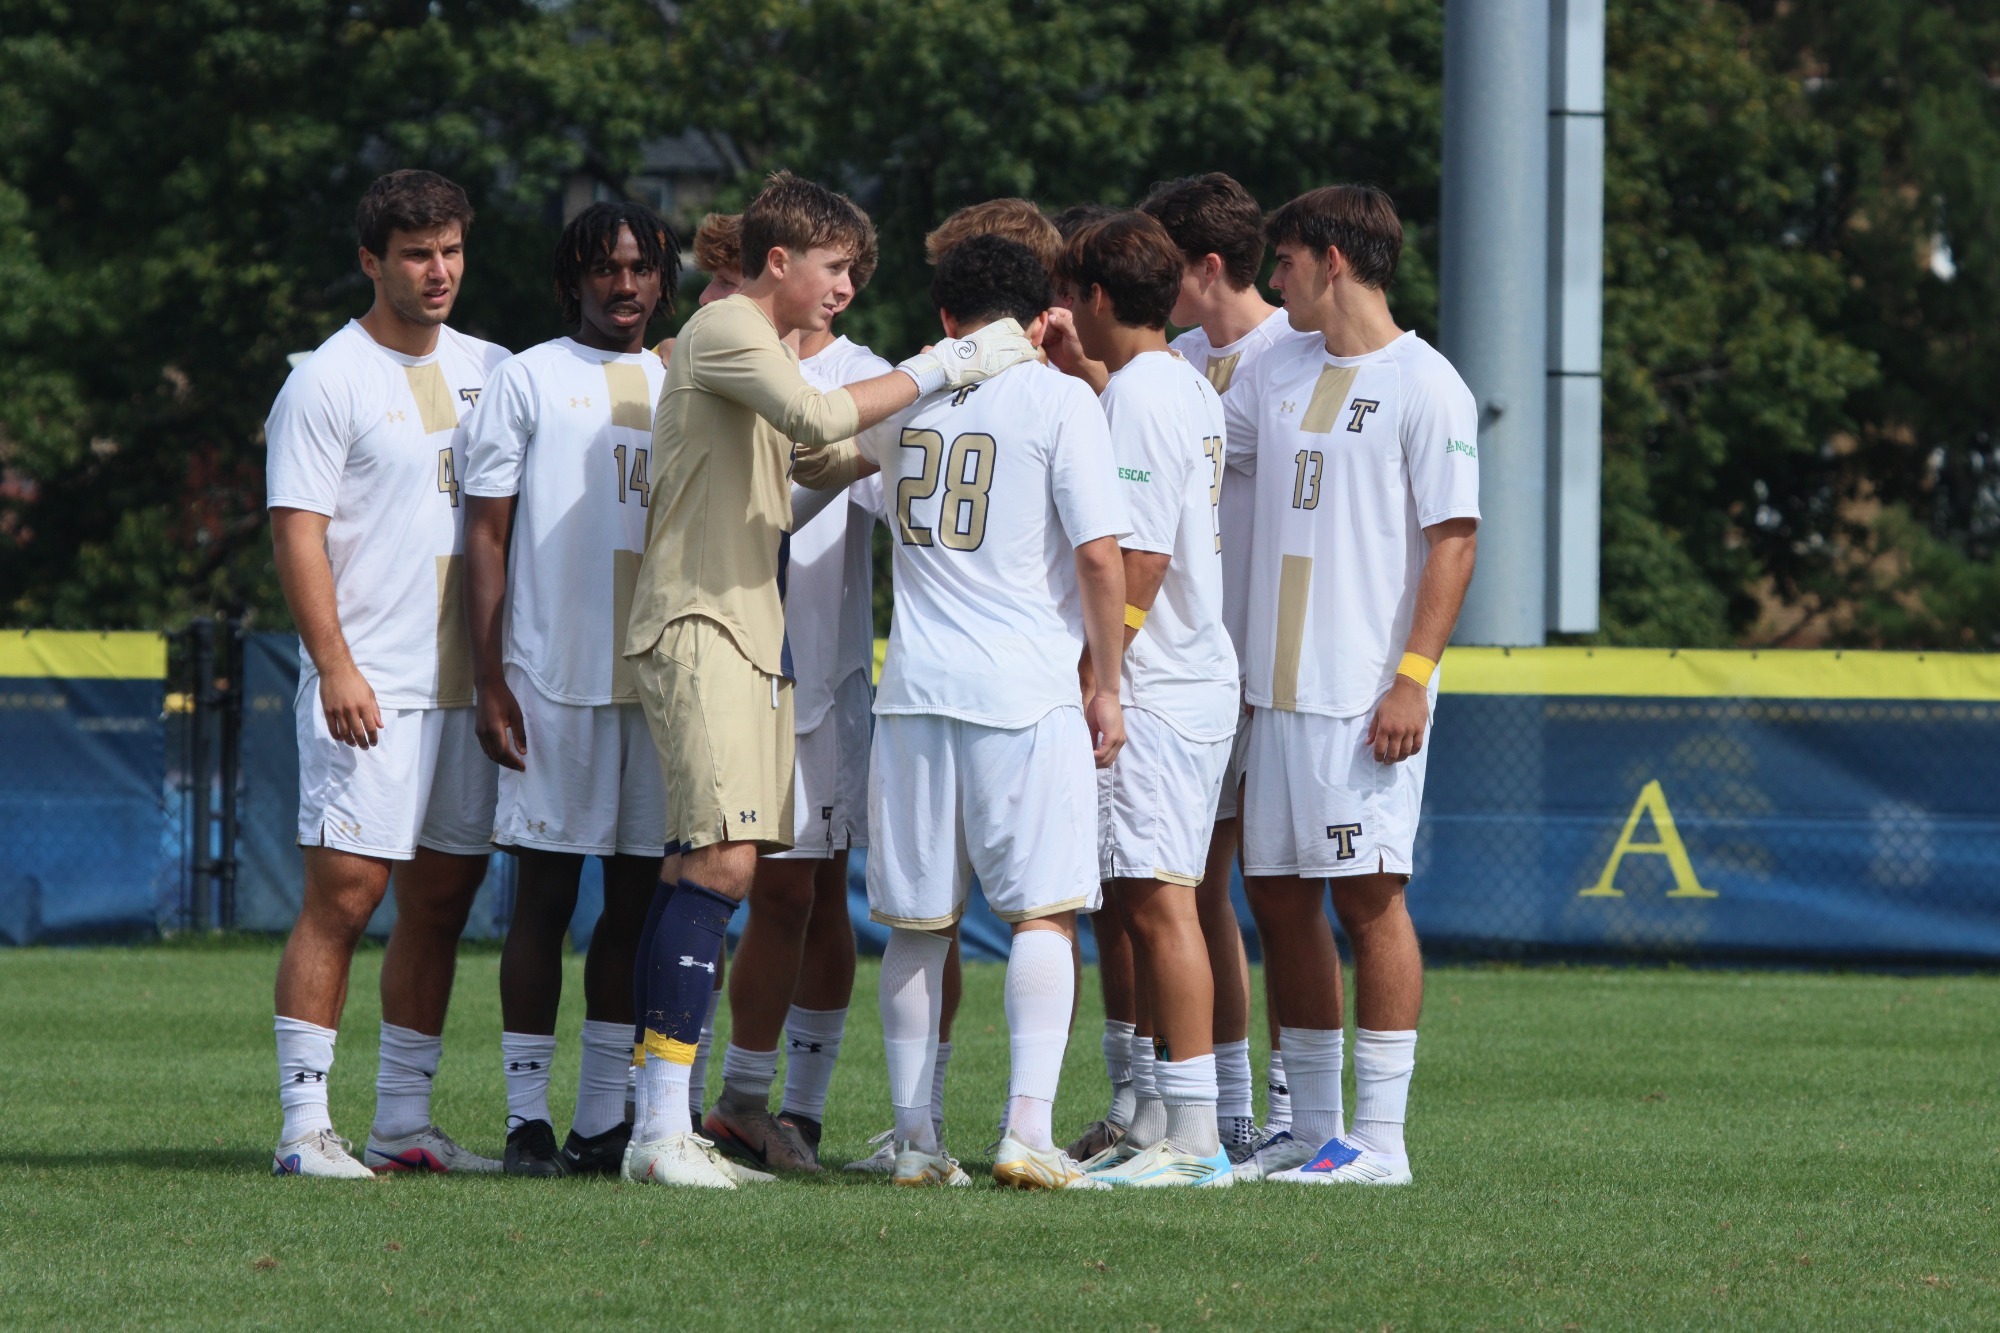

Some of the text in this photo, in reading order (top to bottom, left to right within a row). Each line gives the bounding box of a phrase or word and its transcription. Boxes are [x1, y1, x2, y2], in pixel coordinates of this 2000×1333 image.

[1346, 398, 1380, 433] T
[437, 447, 459, 507] 4
[614, 444, 650, 507] 14
[897, 427, 997, 552] 28
[1117, 467, 1152, 482] ESCAC
[1293, 449, 1324, 510] 13
[1326, 822, 1363, 860] T
[1578, 779, 1719, 898] A
